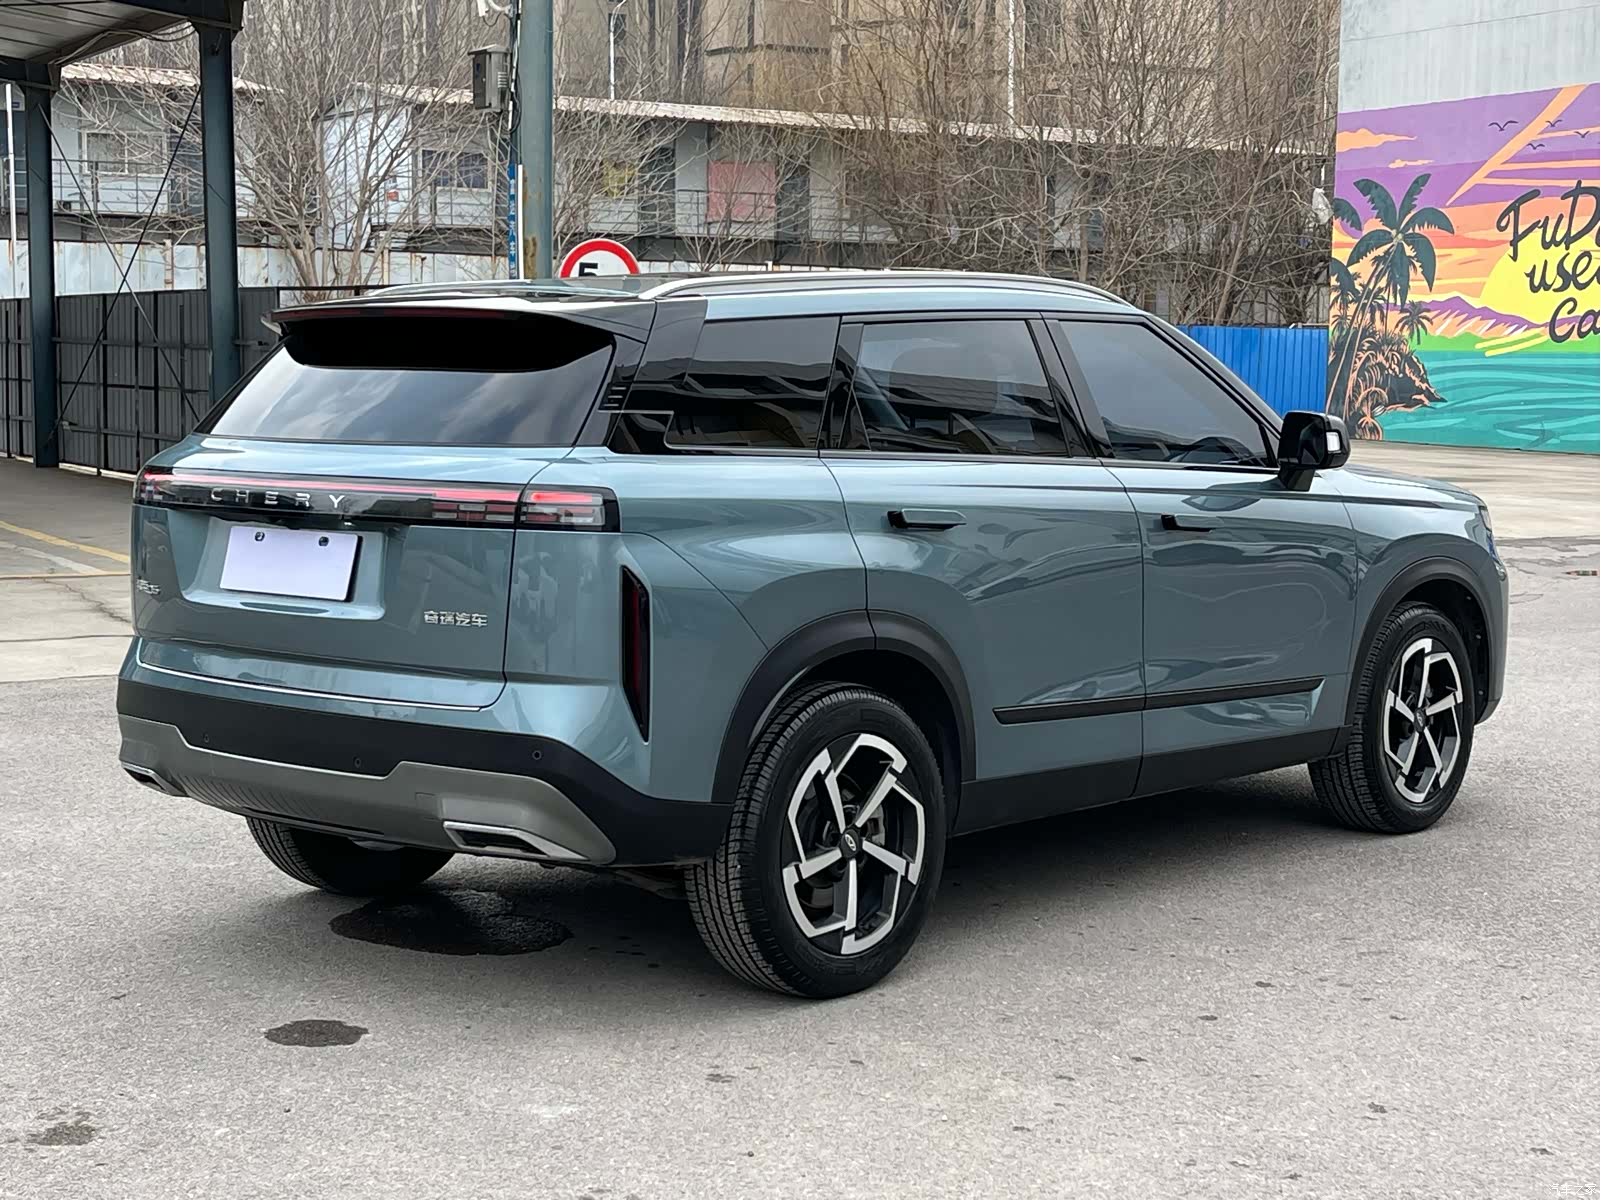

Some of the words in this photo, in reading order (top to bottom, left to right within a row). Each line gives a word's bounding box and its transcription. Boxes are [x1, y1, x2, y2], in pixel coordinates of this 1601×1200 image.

[1496, 179, 1600, 262] FuD
[1524, 252, 1600, 294] use
[210, 487, 345, 509] CHERY
[423, 610, 488, 627] 奇瑞汽车
